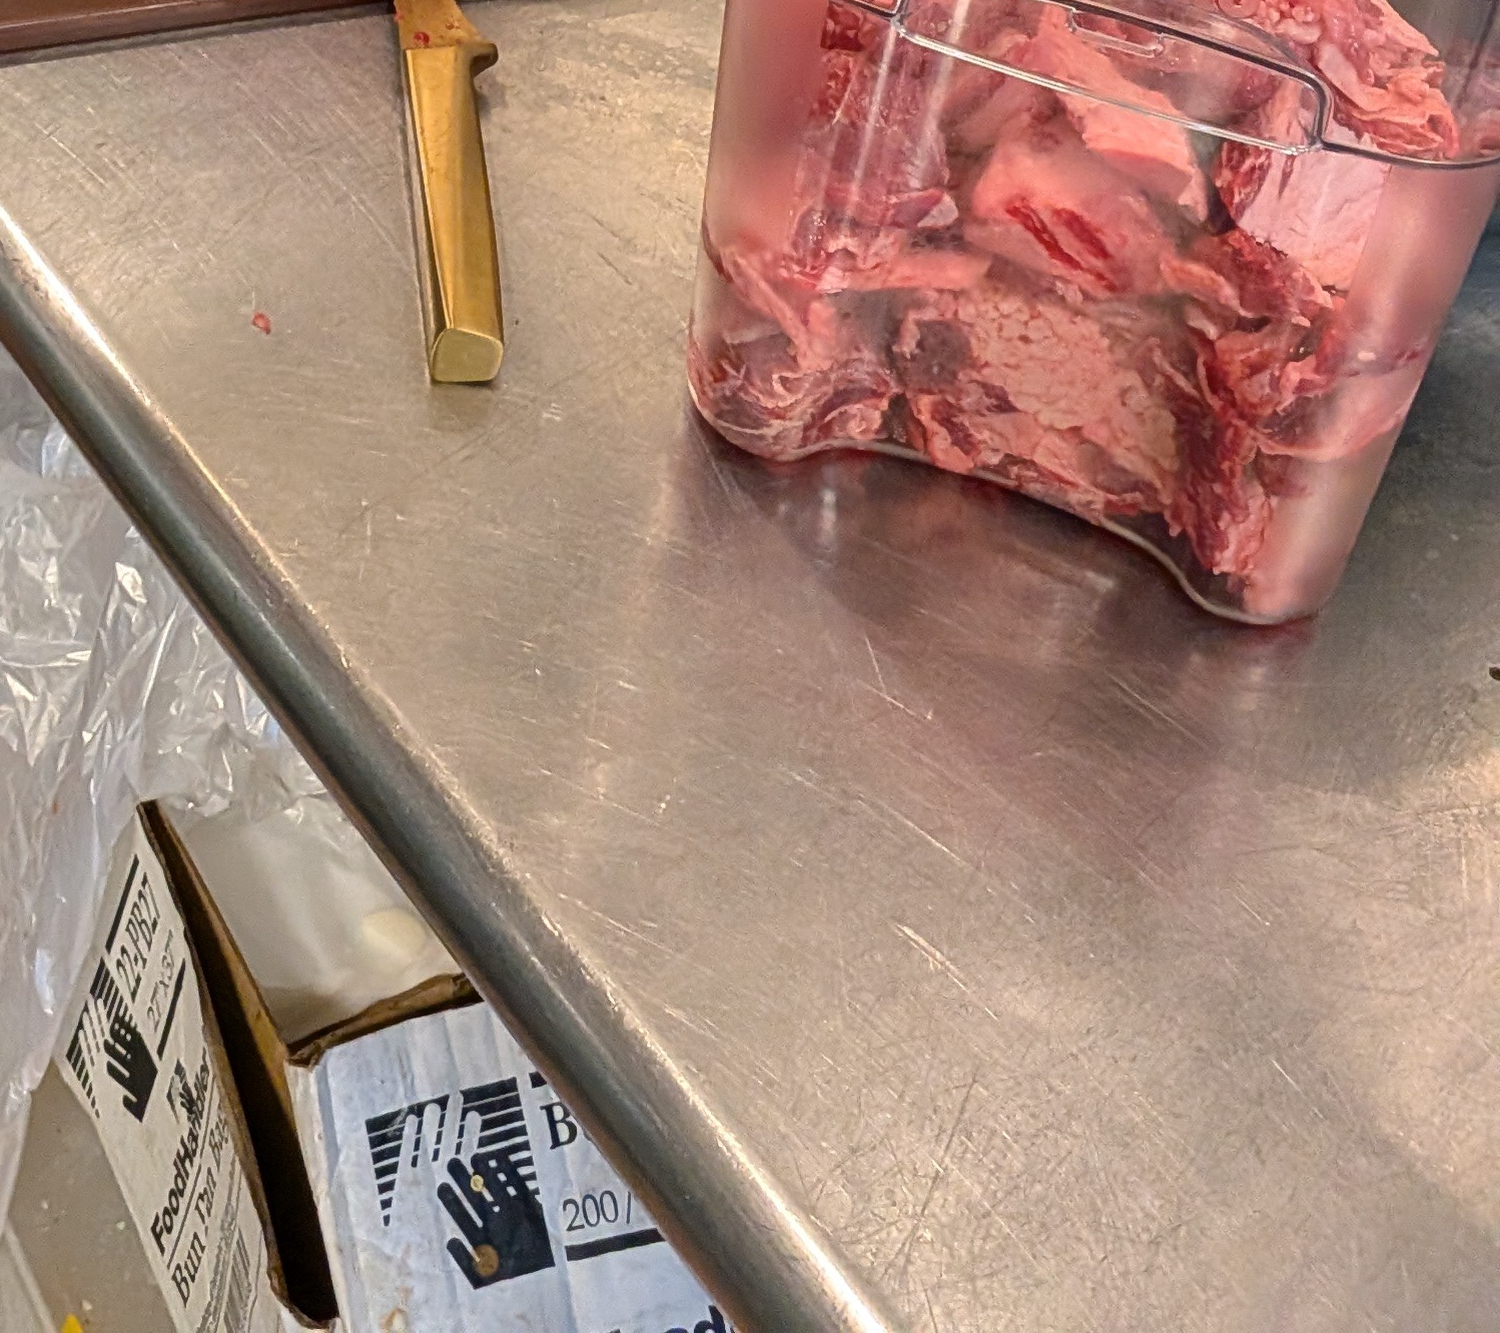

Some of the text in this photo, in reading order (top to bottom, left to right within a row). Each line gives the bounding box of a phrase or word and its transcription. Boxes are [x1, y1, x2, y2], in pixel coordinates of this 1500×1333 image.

[115, 871, 162, 1004] 22-PB27
[149, 1045, 211, 1257] FoodHandler
[171, 1231, 208, 1309] Bun
